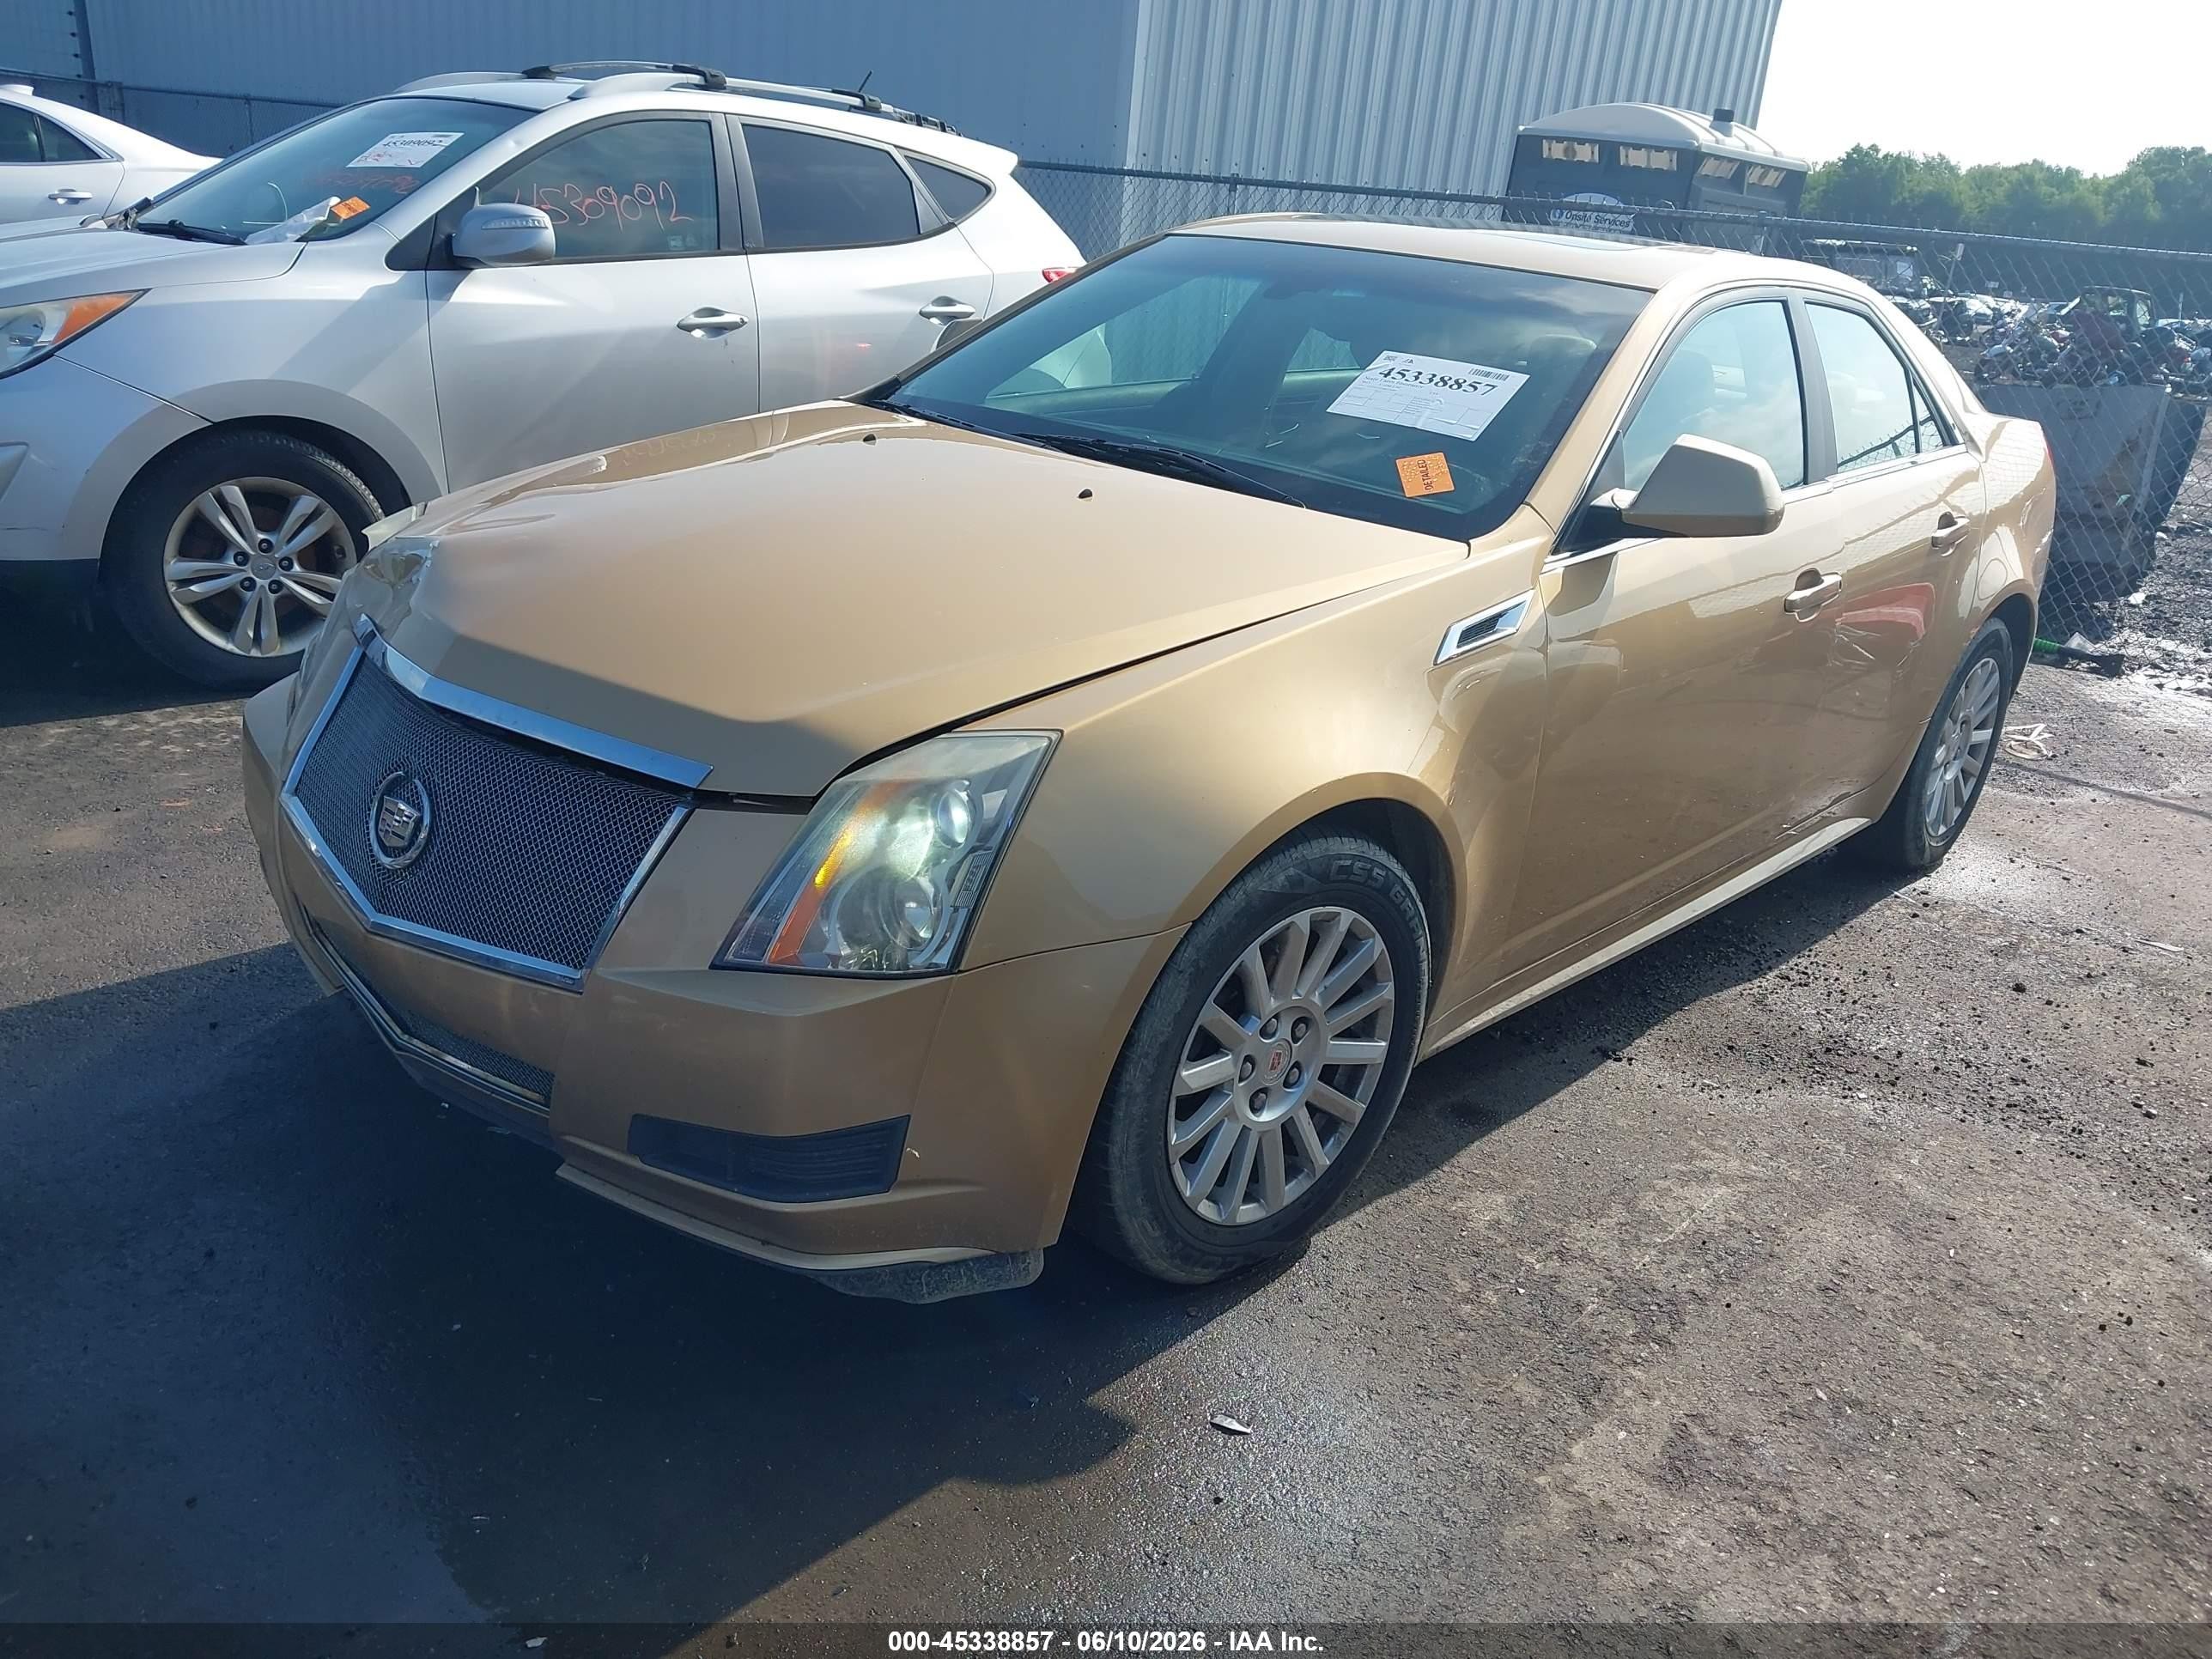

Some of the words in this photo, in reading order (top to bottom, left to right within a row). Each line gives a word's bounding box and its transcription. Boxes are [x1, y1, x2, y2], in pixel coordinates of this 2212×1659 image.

[1593, 213, 1631, 228] Services
[1378, 367, 1498, 396] 45338857
[1417, 459, 1434, 491] DETAILED
